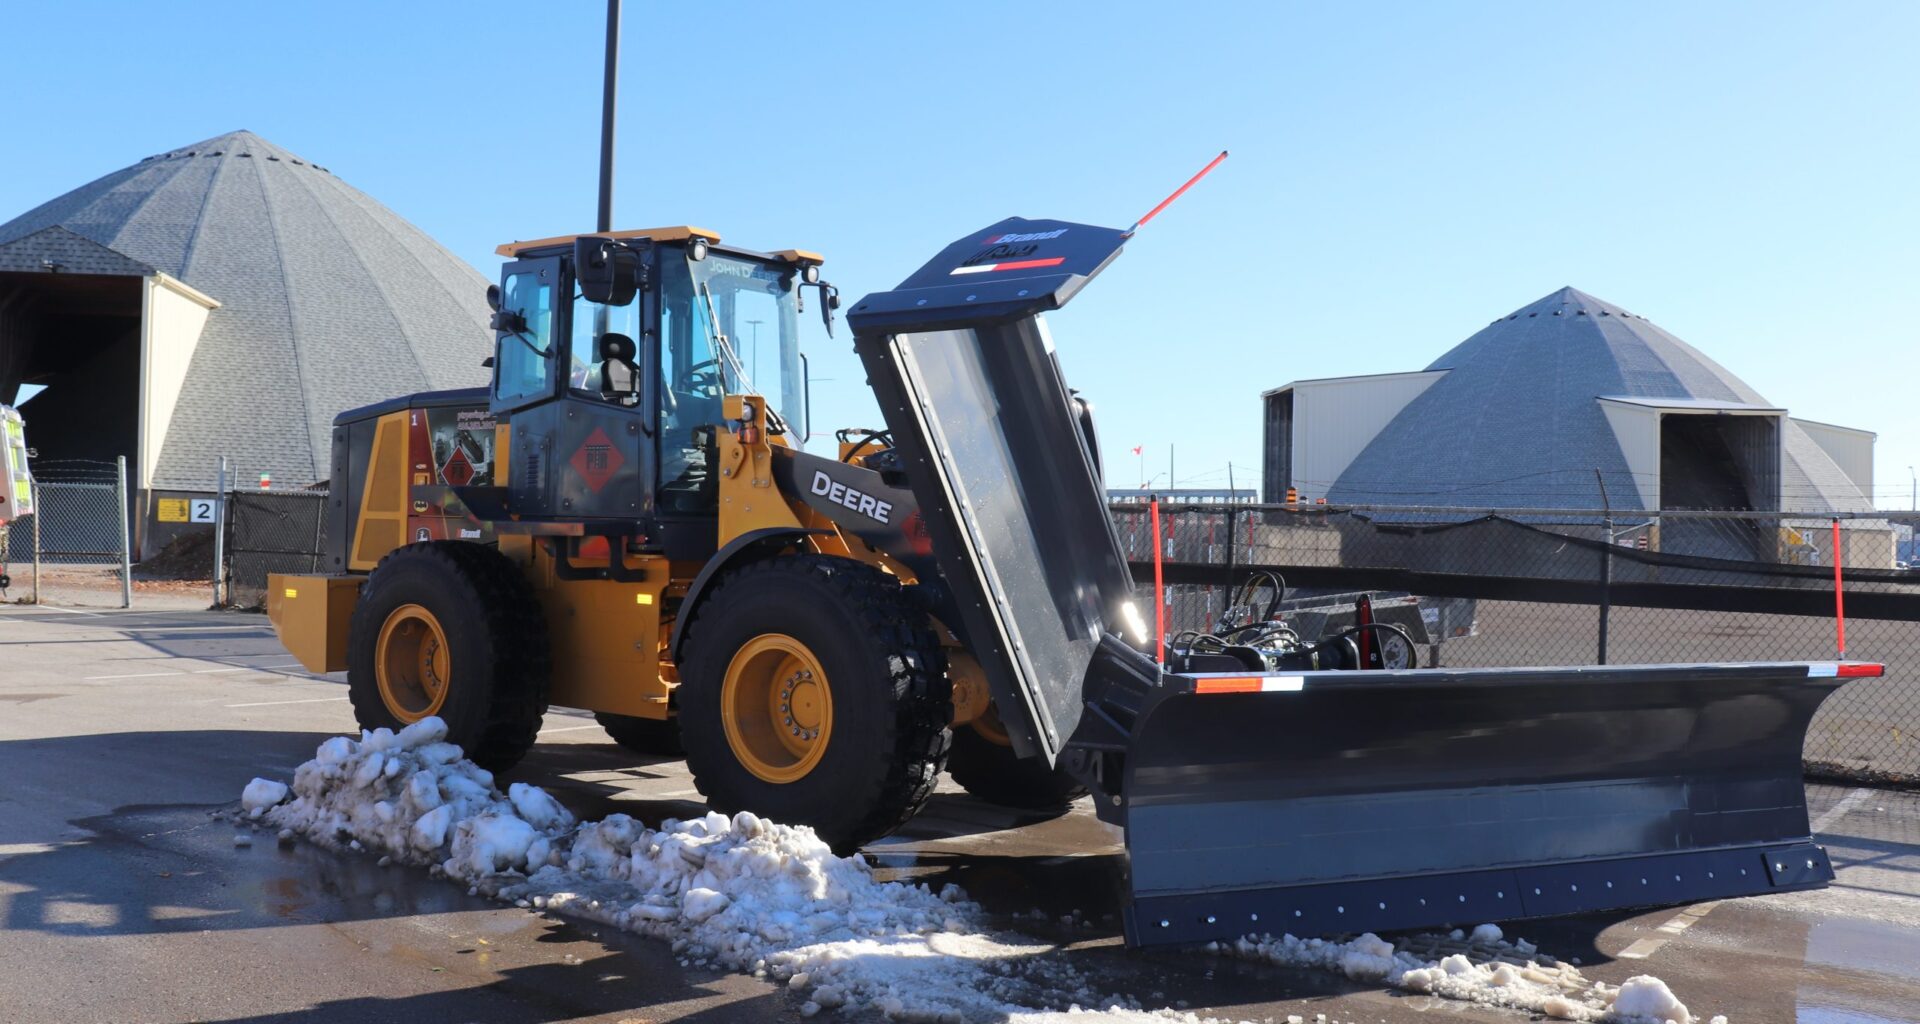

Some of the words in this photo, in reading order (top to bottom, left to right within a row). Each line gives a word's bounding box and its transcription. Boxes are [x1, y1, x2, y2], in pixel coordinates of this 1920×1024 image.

[710, 260, 740, 277] JOHN
[411, 414, 418, 426] 1
[811, 470, 893, 524] DEERE
[197, 503, 210, 519] 2
